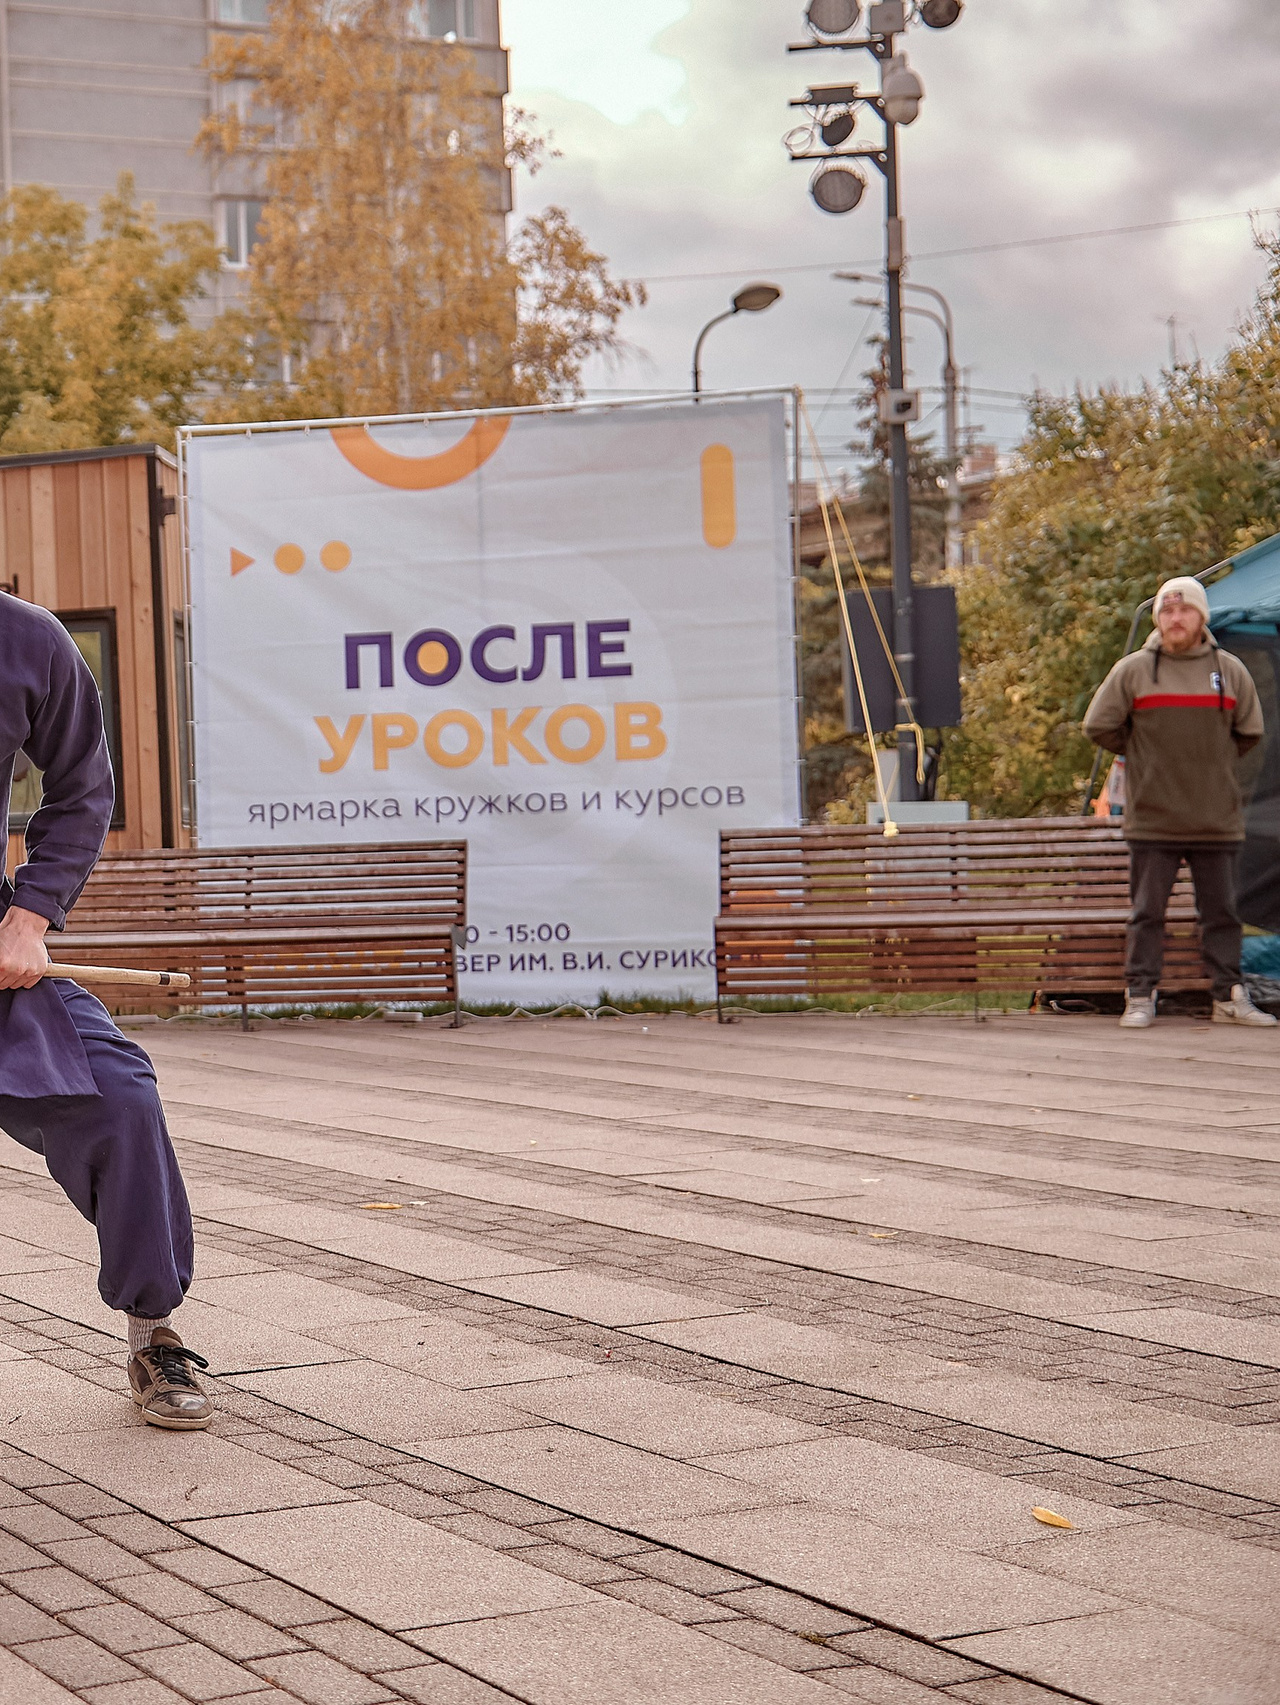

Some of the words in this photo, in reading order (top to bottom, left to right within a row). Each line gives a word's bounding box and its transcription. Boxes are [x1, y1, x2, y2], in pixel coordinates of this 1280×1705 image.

[344, 618, 632, 689] ПОСЛЕ
[313, 701, 668, 774] УРОКОВ
[248, 797, 402, 829] ярмарка
[415, 791, 568, 823] кружков
[582, 790, 601, 811] и
[615, 785, 745, 816] курсов
[505, 922, 570, 943] 15:00
[456, 953, 501, 973] ВЕР
[509, 952, 554, 972] ИМ.
[563, 951, 611, 971] В.И.
